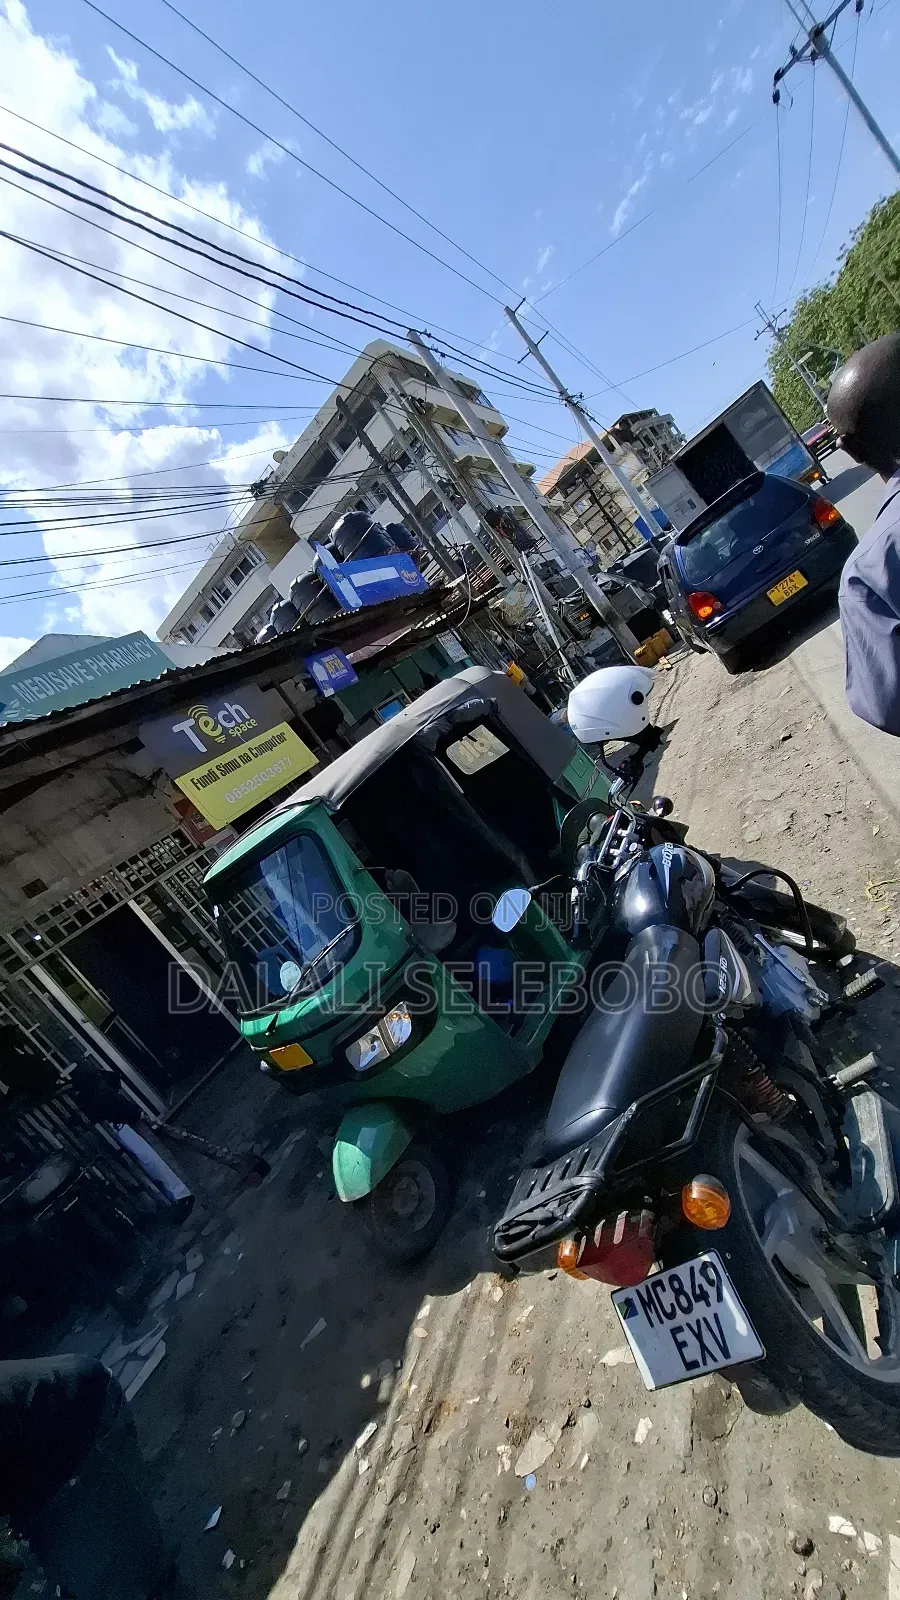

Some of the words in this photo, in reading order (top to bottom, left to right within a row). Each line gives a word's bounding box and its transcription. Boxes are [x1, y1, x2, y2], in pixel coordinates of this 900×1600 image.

[11, 661, 93, 704] MEDISAVE
[90, 639, 158, 677] PHARMACY
[172, 702, 250, 753] Tech
[229, 717, 258, 738] space
[190, 768, 220, 791] Fundi
[216, 758, 242, 777] Simu
[238, 752, 252, 769] na
[249, 732, 287, 760] Computer
[636, 1261, 723, 1328] MC849
[670, 1313, 731, 1371] EXV
